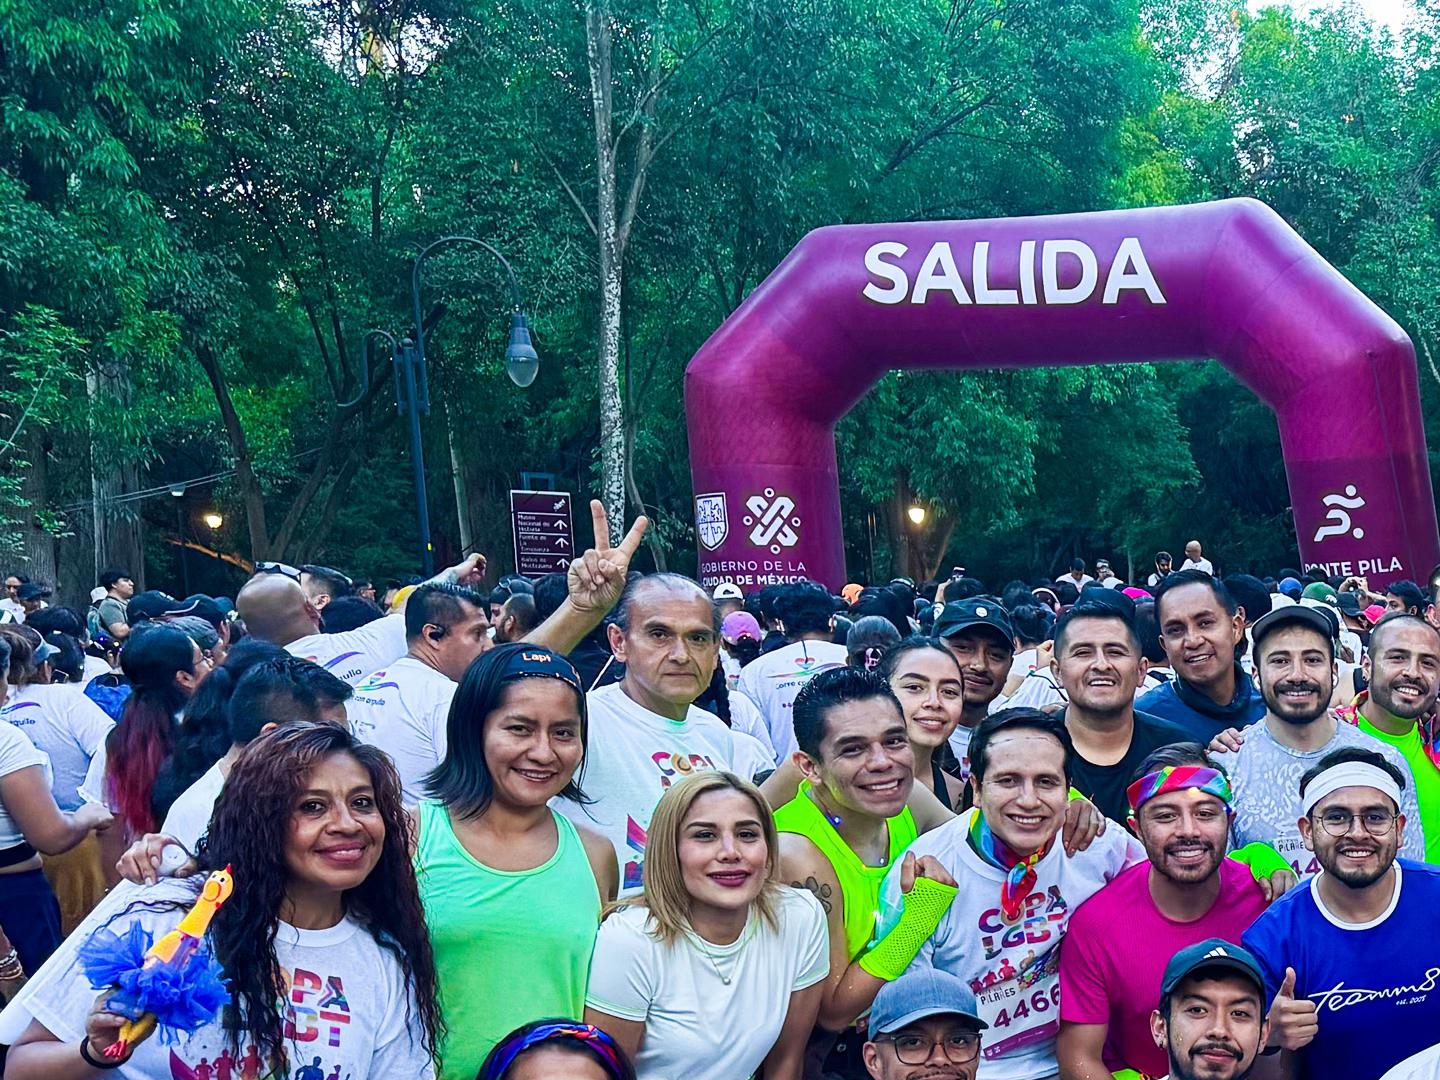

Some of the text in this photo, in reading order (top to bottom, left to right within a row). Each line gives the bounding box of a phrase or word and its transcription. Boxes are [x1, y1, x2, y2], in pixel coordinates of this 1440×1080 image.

[862, 237, 1168, 305] SALIDA
[702, 560, 806, 573] GOBIERNO DE LA
[1358, 556, 1403, 576] PILA
[736, 575, 754, 585] DE
[1290, 857, 1322, 875] 44
[280, 967, 351, 1012] PA
[980, 987, 1016, 1005] PILARES
